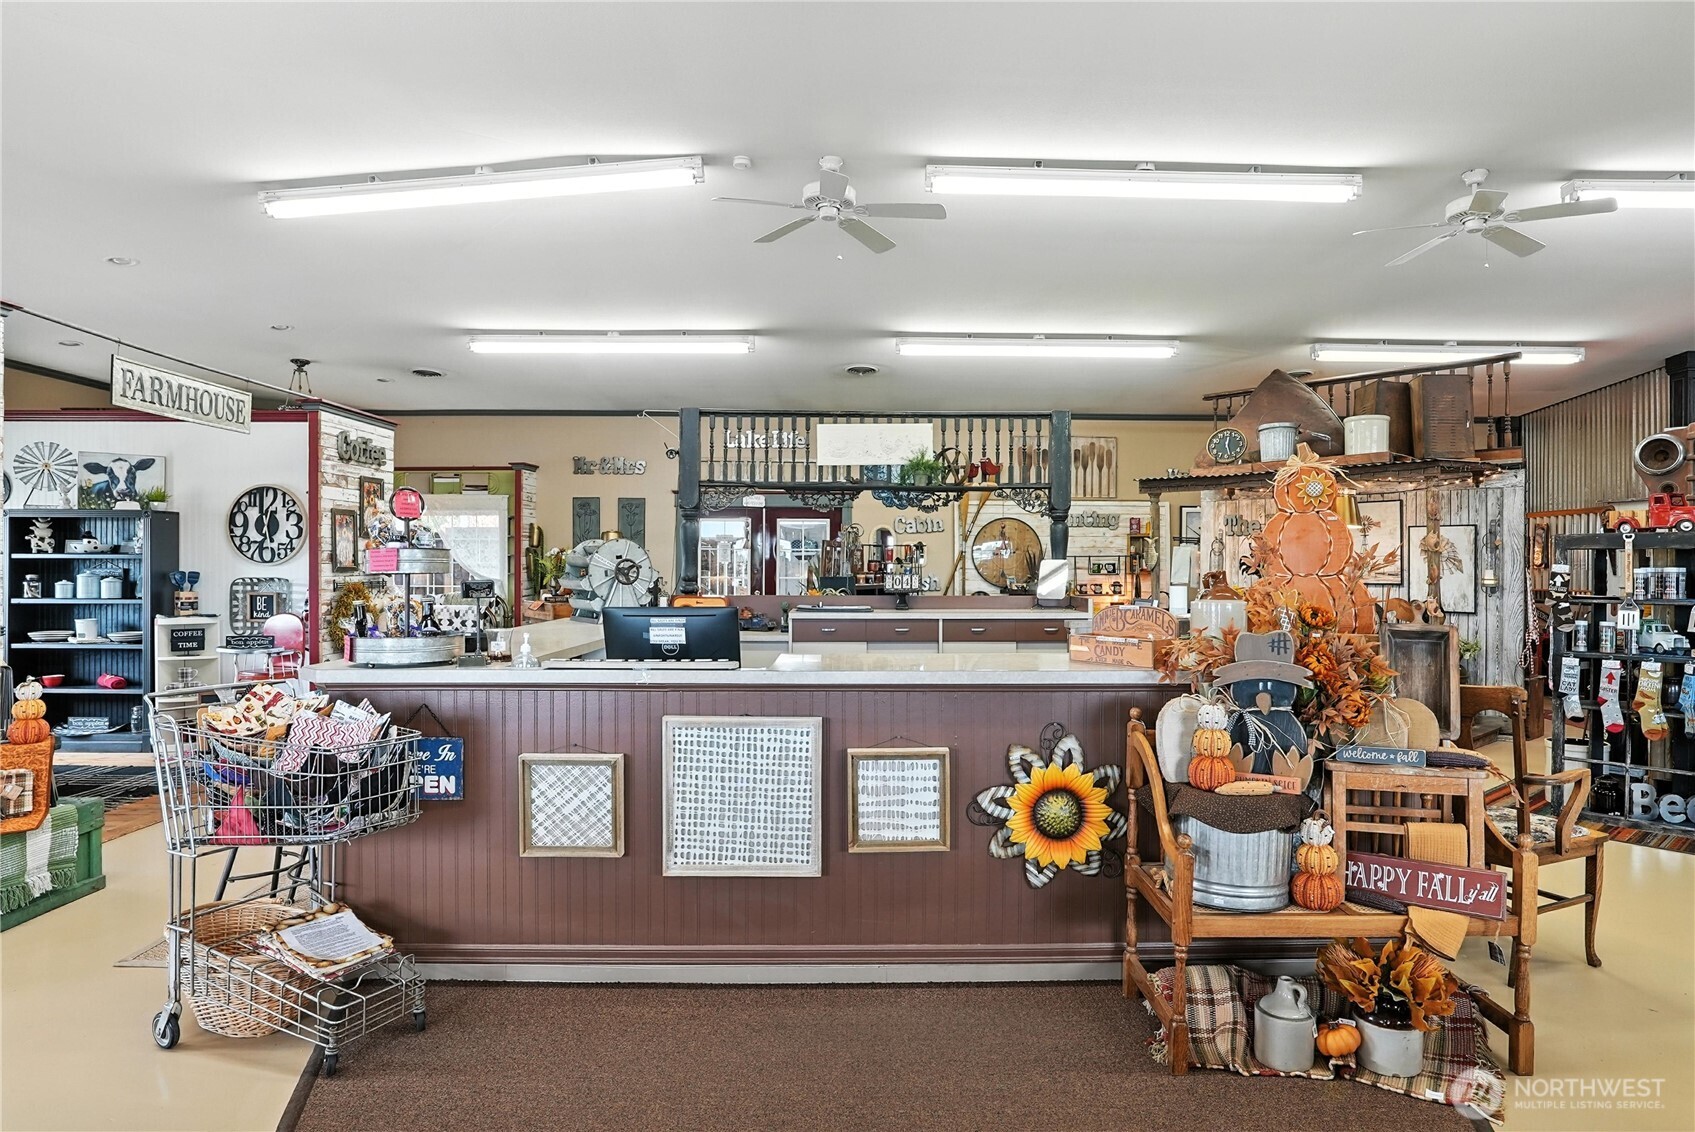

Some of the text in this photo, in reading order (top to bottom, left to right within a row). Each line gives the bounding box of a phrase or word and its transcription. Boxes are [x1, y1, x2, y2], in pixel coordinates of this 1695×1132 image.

[120, 367, 246, 425] FARMHOUSE
[337, 430, 387, 466] Coffee
[572, 455, 597, 475] Mr
[612, 456, 647, 475] Mrs
[237, 500, 249, 512] 10
[248, 491, 258, 508] 11
[256, 487, 278, 515] 12
[281, 491, 287, 508] 1
[286, 499, 297, 513] 2
[230, 510, 249, 538] 9
[286, 512, 303, 540] 3
[894, 515, 945, 535] Cabin
[1067, 510, 1120, 531] nting
[1223, 514, 1262, 537] The
[238, 535, 251, 553] 8
[250, 540, 260, 560] 7
[258, 536, 276, 563] 6
[277, 543, 288, 560] 5
[286, 539, 296, 553] 4
[921, 573, 941, 591] sh
[256, 596, 268, 611] BE
[253, 611, 272, 619] kind
[1124, 606, 1175, 637] CARAMELS
[1094, 645, 1125, 657] CANDY
[434, 744, 457, 761] In
[1343, 747, 1419, 763] welcome fall
[409, 775, 456, 794] PEN
[1345, 860, 1500, 904] HAPPY FALL y'all
